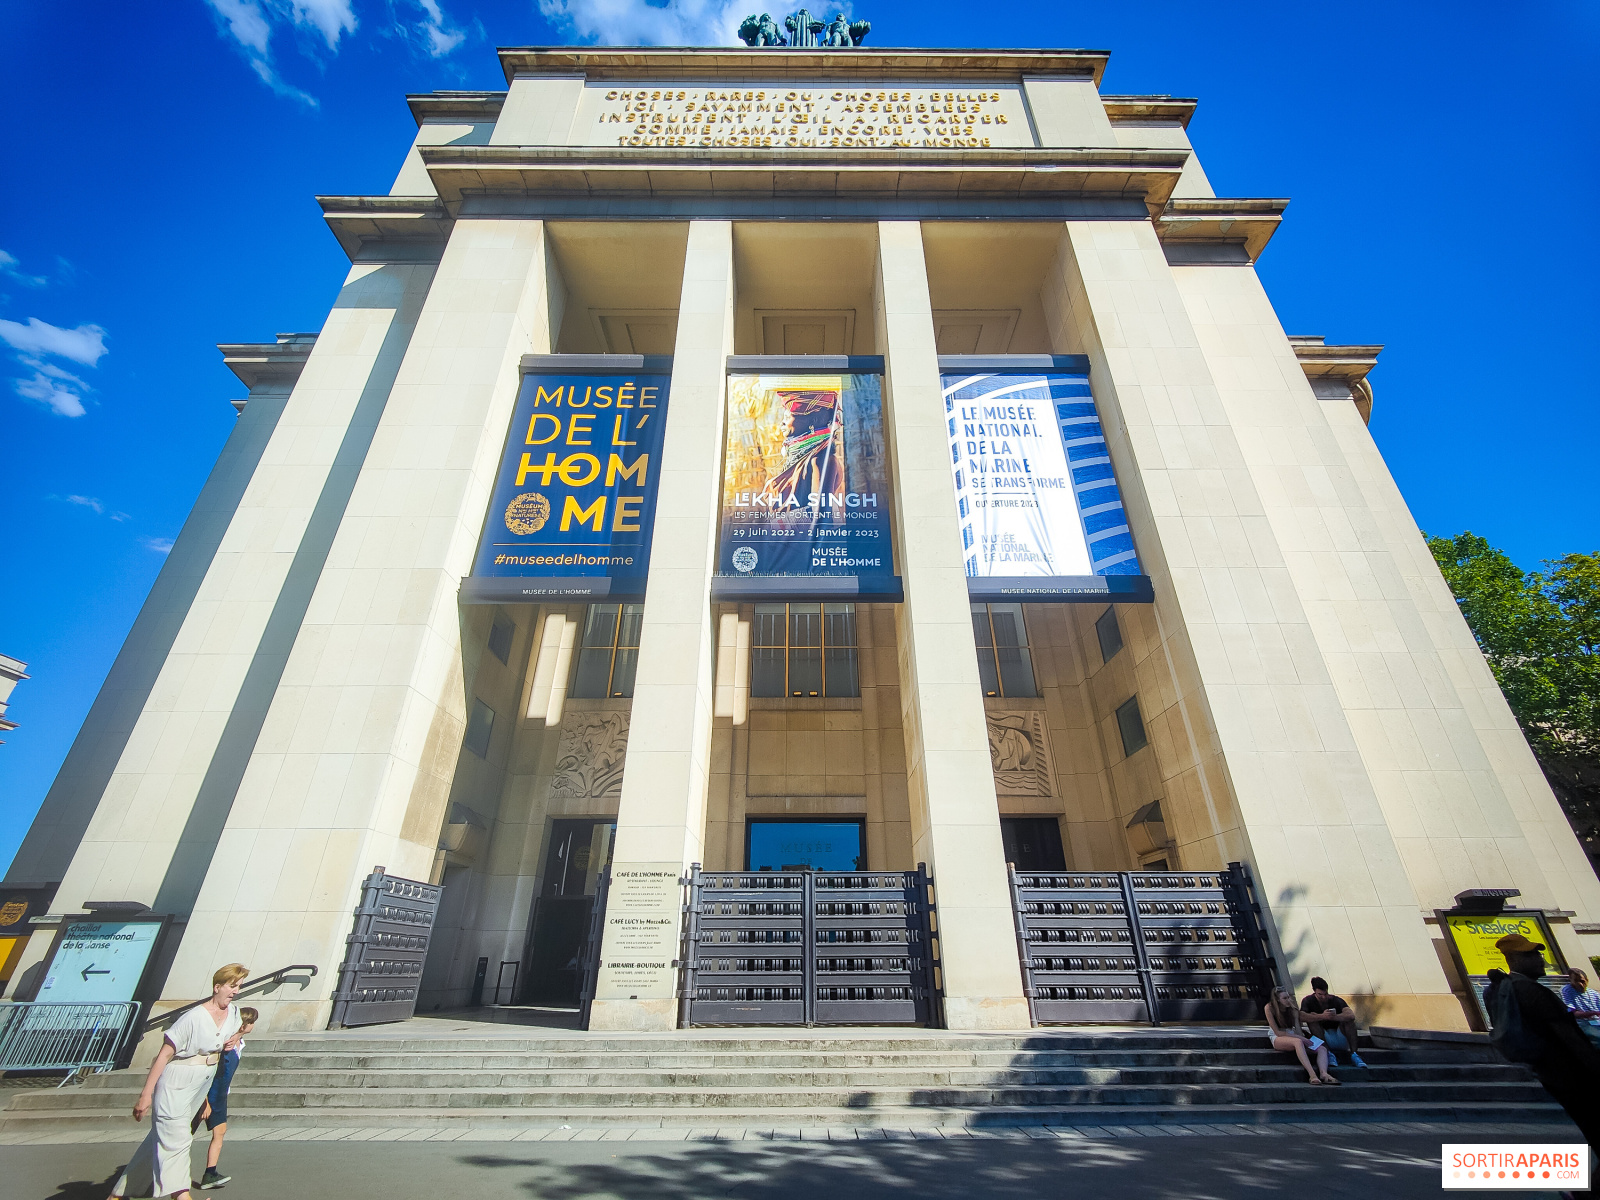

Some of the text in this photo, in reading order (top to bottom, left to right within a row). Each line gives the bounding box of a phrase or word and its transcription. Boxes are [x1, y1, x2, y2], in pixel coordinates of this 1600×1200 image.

[606, 91, 1001, 102] CHOSES RARES OU CHOSES BELLES
[625, 102, 657, 112] ICI
[686, 102, 815, 113] SAVAMMENT
[599, 112, 747, 123] INSTRUISENT
[853, 114, 866, 124] A
[888, 113, 1009, 125] REGARDER
[634, 124, 974, 136] COMME JAMAIS ENCORE VUES
[618, 135, 687, 146] TOUTES
[699, 136, 772, 146] CHOSES
[829, 136, 879, 147] SONT
[890, 137, 912, 147] AU
[923, 136, 991, 147] MONDE
[533, 382, 659, 409] MUSÉE
[961, 404, 1037, 420] LE MUSÉE
[524, 413, 650, 446] DE L'
[964, 423, 1042, 437] NATIONAL
[967, 440, 1013, 455] DE LA
[514, 452, 649, 487] HOM
[971, 477, 986, 488] SE
[735, 493, 800, 507] LEKHA
[975, 500, 1019, 508] OUERTURE
[559, 495, 644, 532] ME
[749, 511, 786, 519] FEMMES
[789, 511, 832, 519] PORTENT
[834, 511, 841, 519] LE
[844, 511, 878, 519] MONDE
[733, 529, 745, 538] 29
[748, 528, 768, 537] juin
[816, 528, 852, 537] janvier
[855, 530, 879, 538] 2023
[812, 547, 848, 556] MUSÉE
[983, 543, 1031, 553] NAIONAL
[494, 553, 633, 565] #museedelhomme
[812, 558, 881, 566] DE L'HOMME
[999, 552, 1012, 562] LA
[1013, 552, 1054, 563] MARI
[70, 923, 102, 932] chaillot
[98, 931, 136, 940] national
[63, 941, 74, 949] de
[75, 941, 83, 949] la
